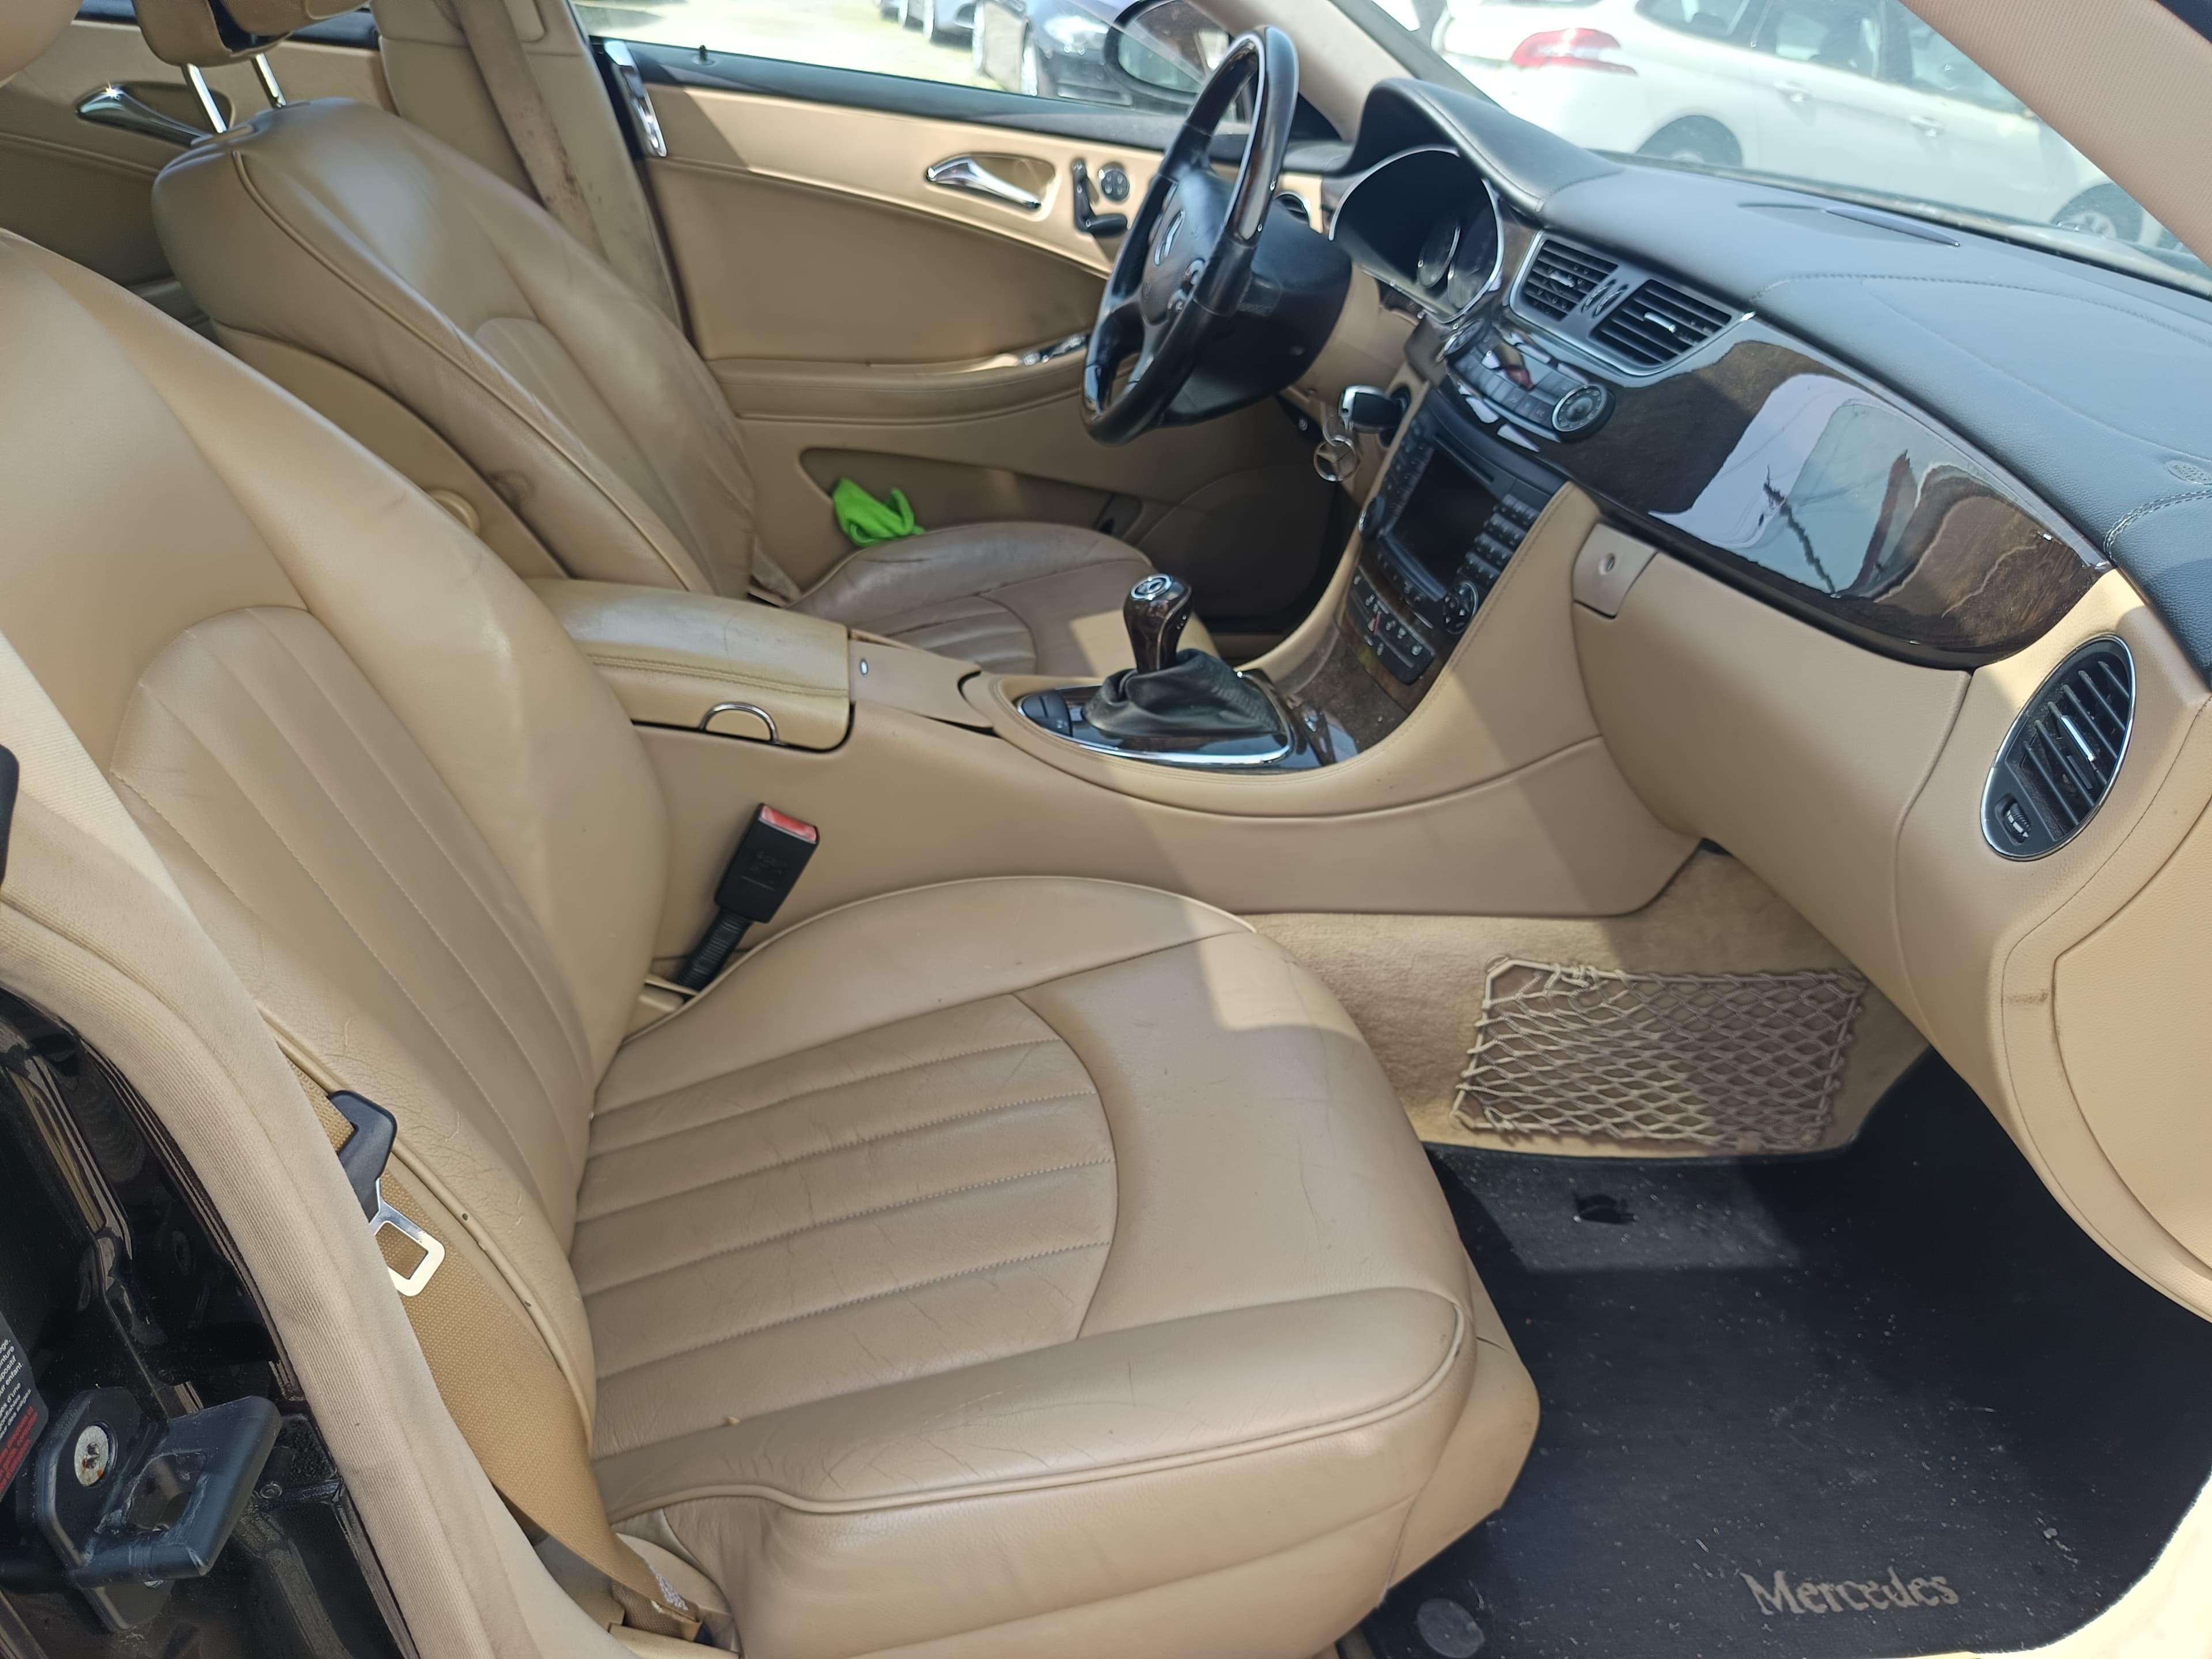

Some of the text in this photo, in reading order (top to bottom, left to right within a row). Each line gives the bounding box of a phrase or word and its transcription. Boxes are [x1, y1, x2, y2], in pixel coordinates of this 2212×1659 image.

[6, 1362, 23, 1385] enfant.
[7, 1382, 21, 1403] d'une
[1740, 1566, 1959, 1616] Mercedes
